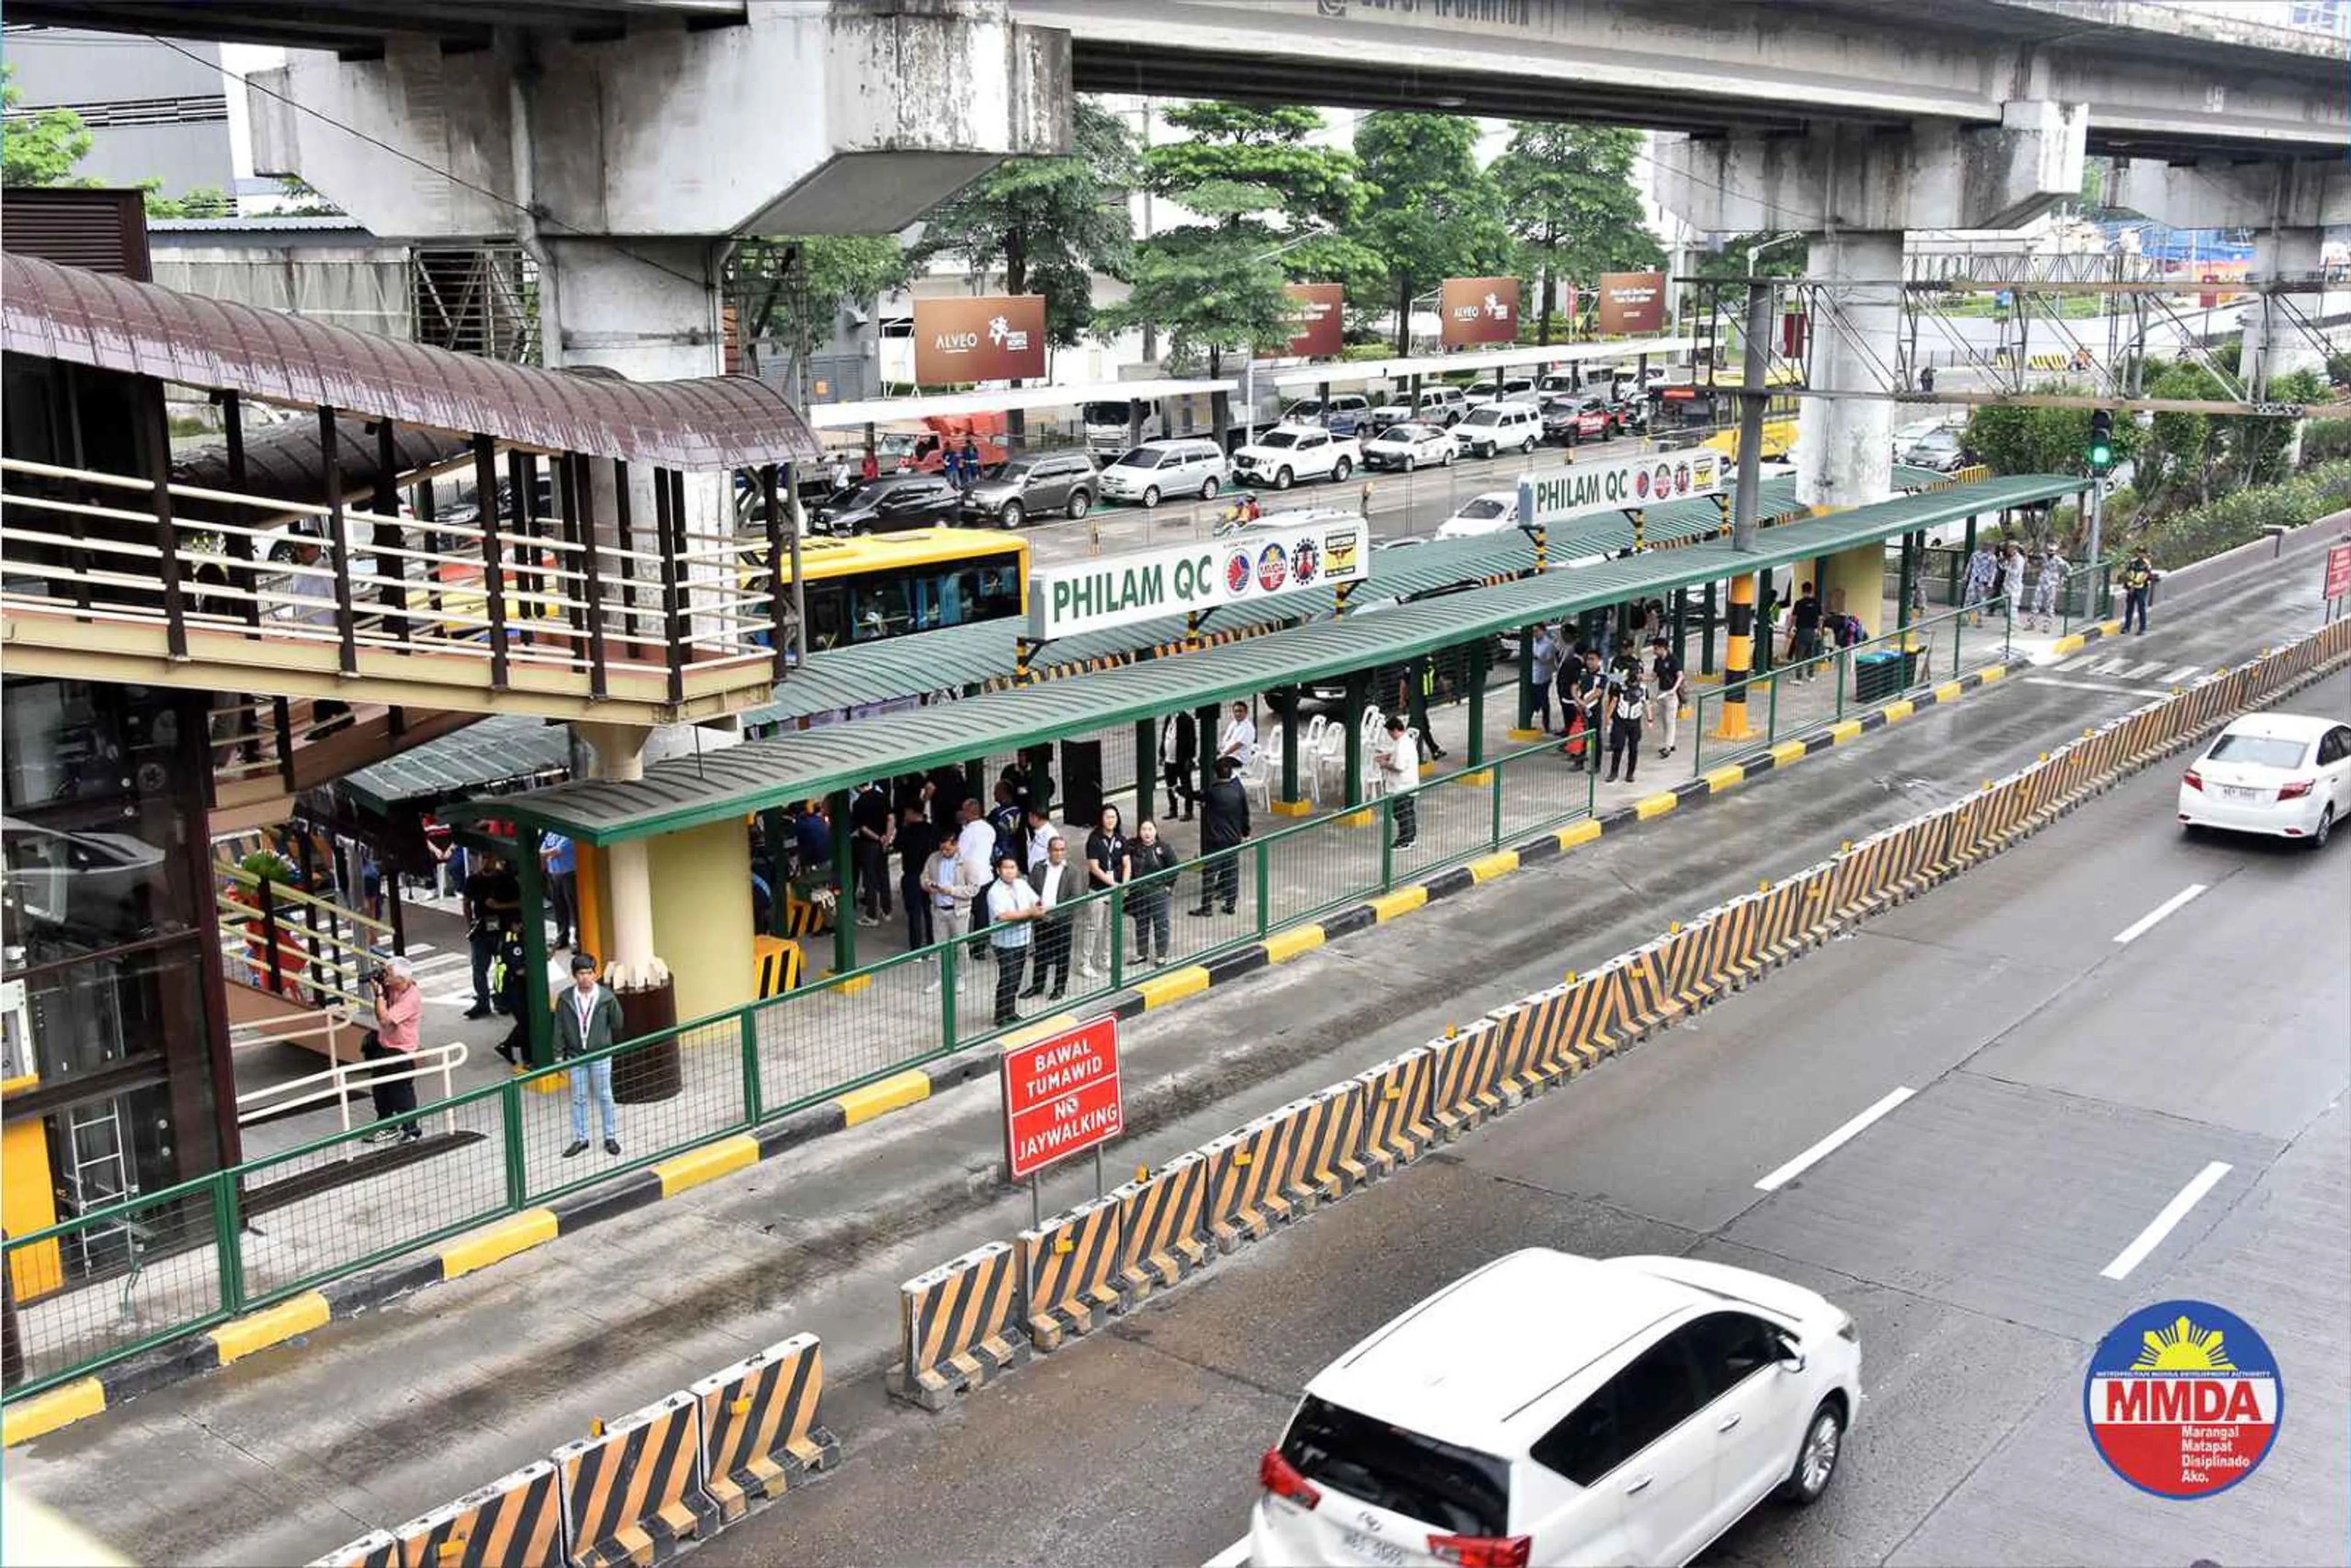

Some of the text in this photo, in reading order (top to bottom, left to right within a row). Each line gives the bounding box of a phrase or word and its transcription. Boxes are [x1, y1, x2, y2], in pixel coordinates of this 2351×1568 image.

[936, 332, 977, 350] ALVEO
[1537, 469, 1628, 513] PHILAM QC
[1054, 555, 1212, 623] PHILAM QC
[1026, 1055, 1103, 1098] TUMAWID
[1035, 1038, 1092, 1072] BAWAL
[1054, 1097, 1079, 1121] NO
[1018, 1104, 1117, 1161] JAYWALKING
